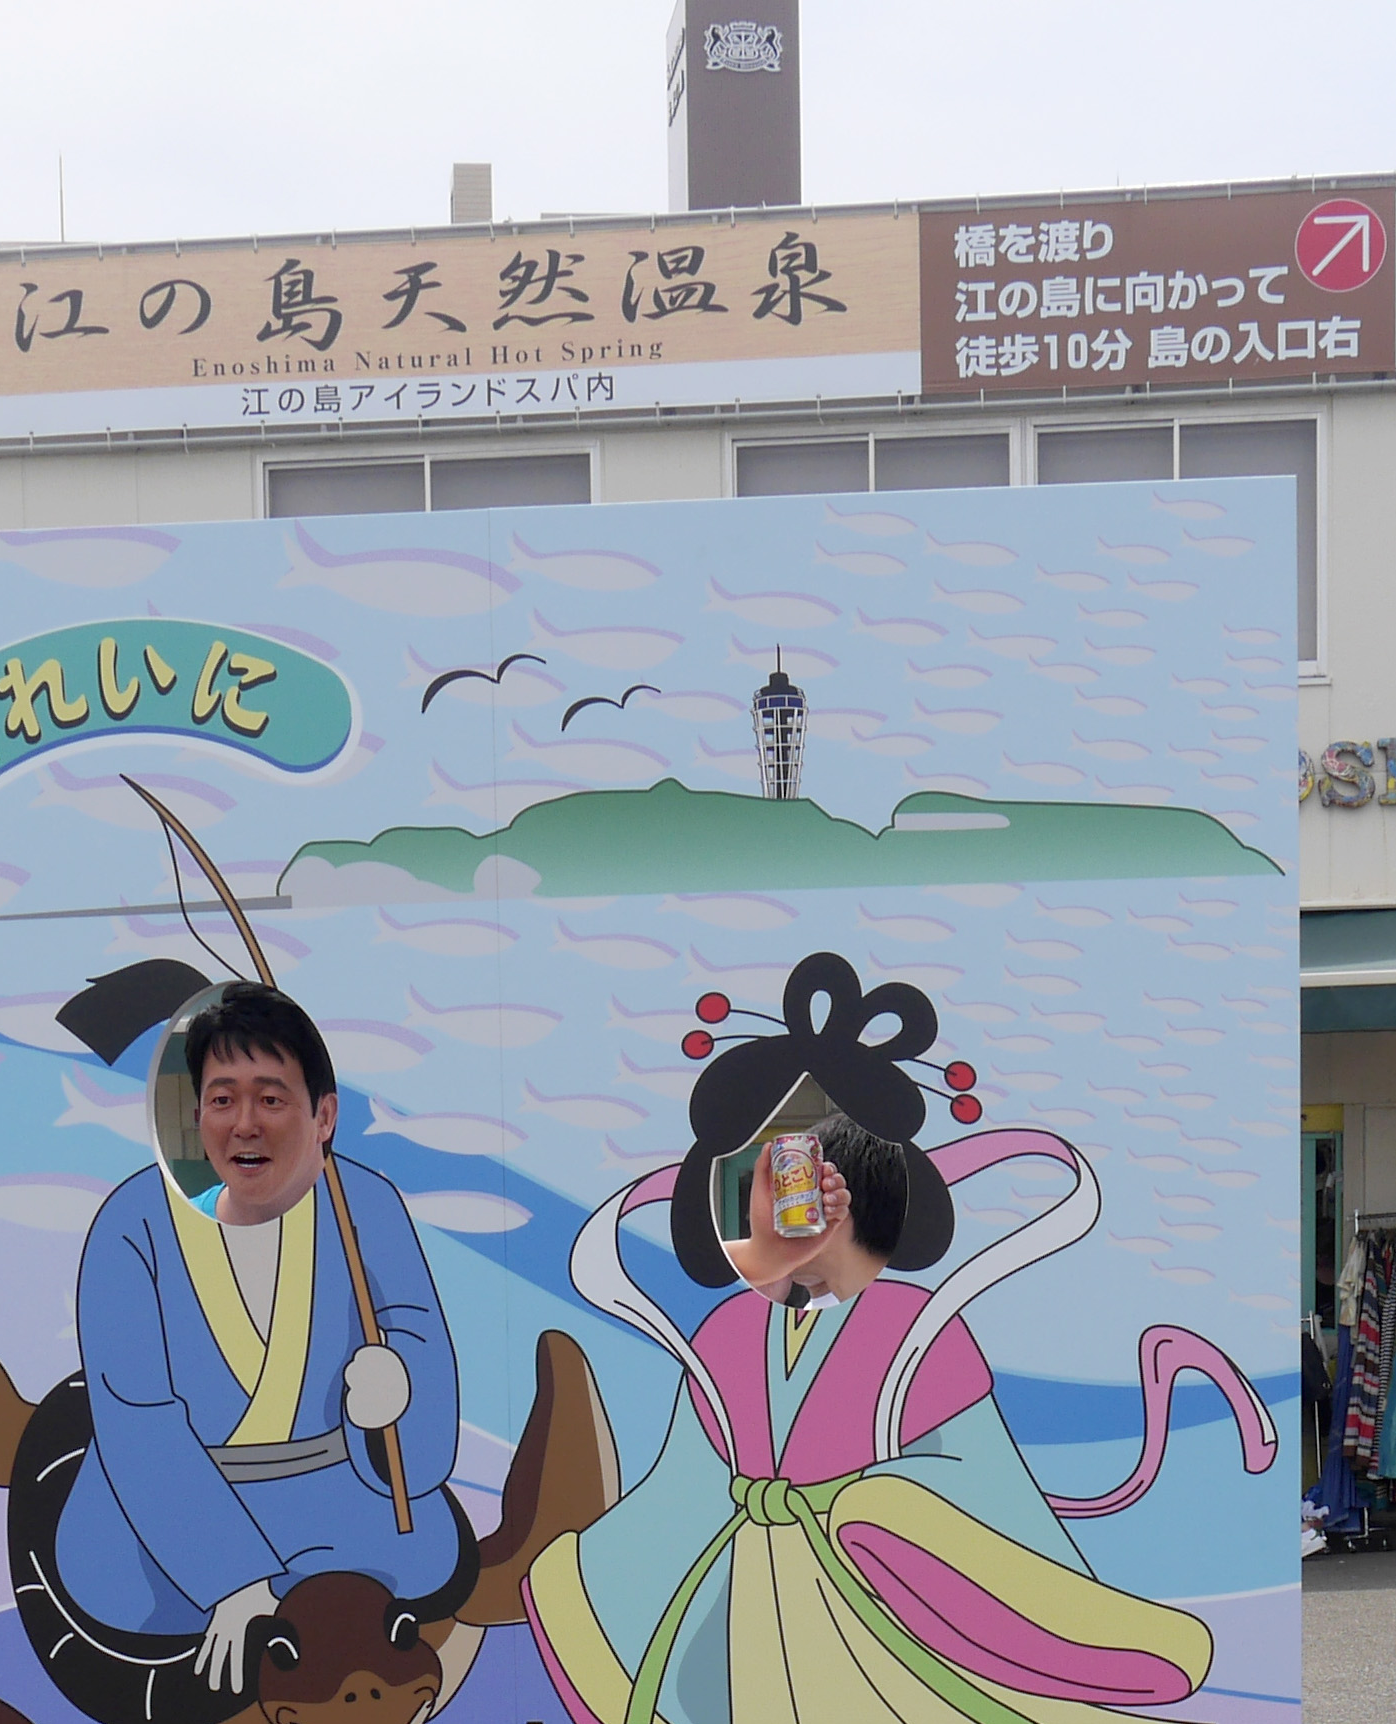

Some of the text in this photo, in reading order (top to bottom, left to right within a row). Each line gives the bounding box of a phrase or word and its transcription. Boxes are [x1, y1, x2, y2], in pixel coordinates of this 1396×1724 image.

[953, 219, 1114, 267] 橋を渡り
[16, 231, 849, 354] 江の島天然温泉
[954, 265, 1289, 323] 江の島に向かって
[192, 338, 664, 378] Enoshima Natural Hot Spring
[954, 315, 1362, 379] 徒歩10分 島の入口右
[241, 371, 615, 417] 江の島アイランドスパ内
